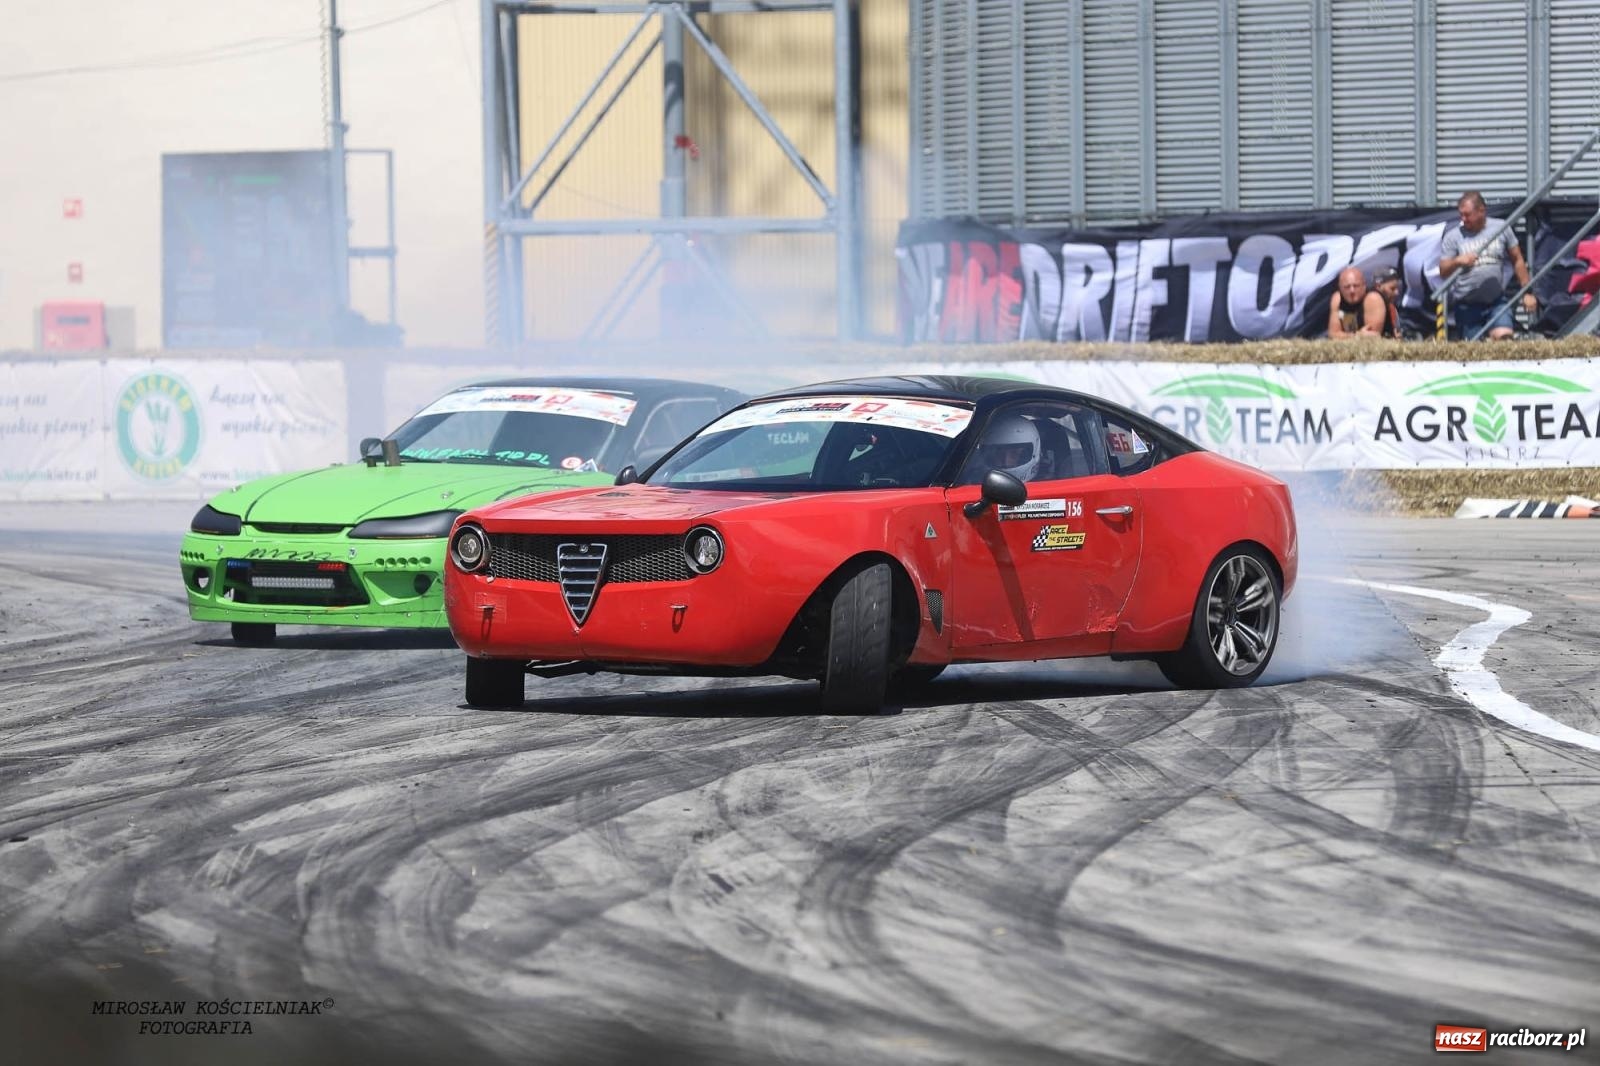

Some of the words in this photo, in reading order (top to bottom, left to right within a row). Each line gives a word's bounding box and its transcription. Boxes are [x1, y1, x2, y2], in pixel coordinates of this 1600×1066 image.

[1067, 501, 1082, 517] 156
[1050, 526, 1067, 534] RACE
[1056, 535, 1084, 544] STREETS
